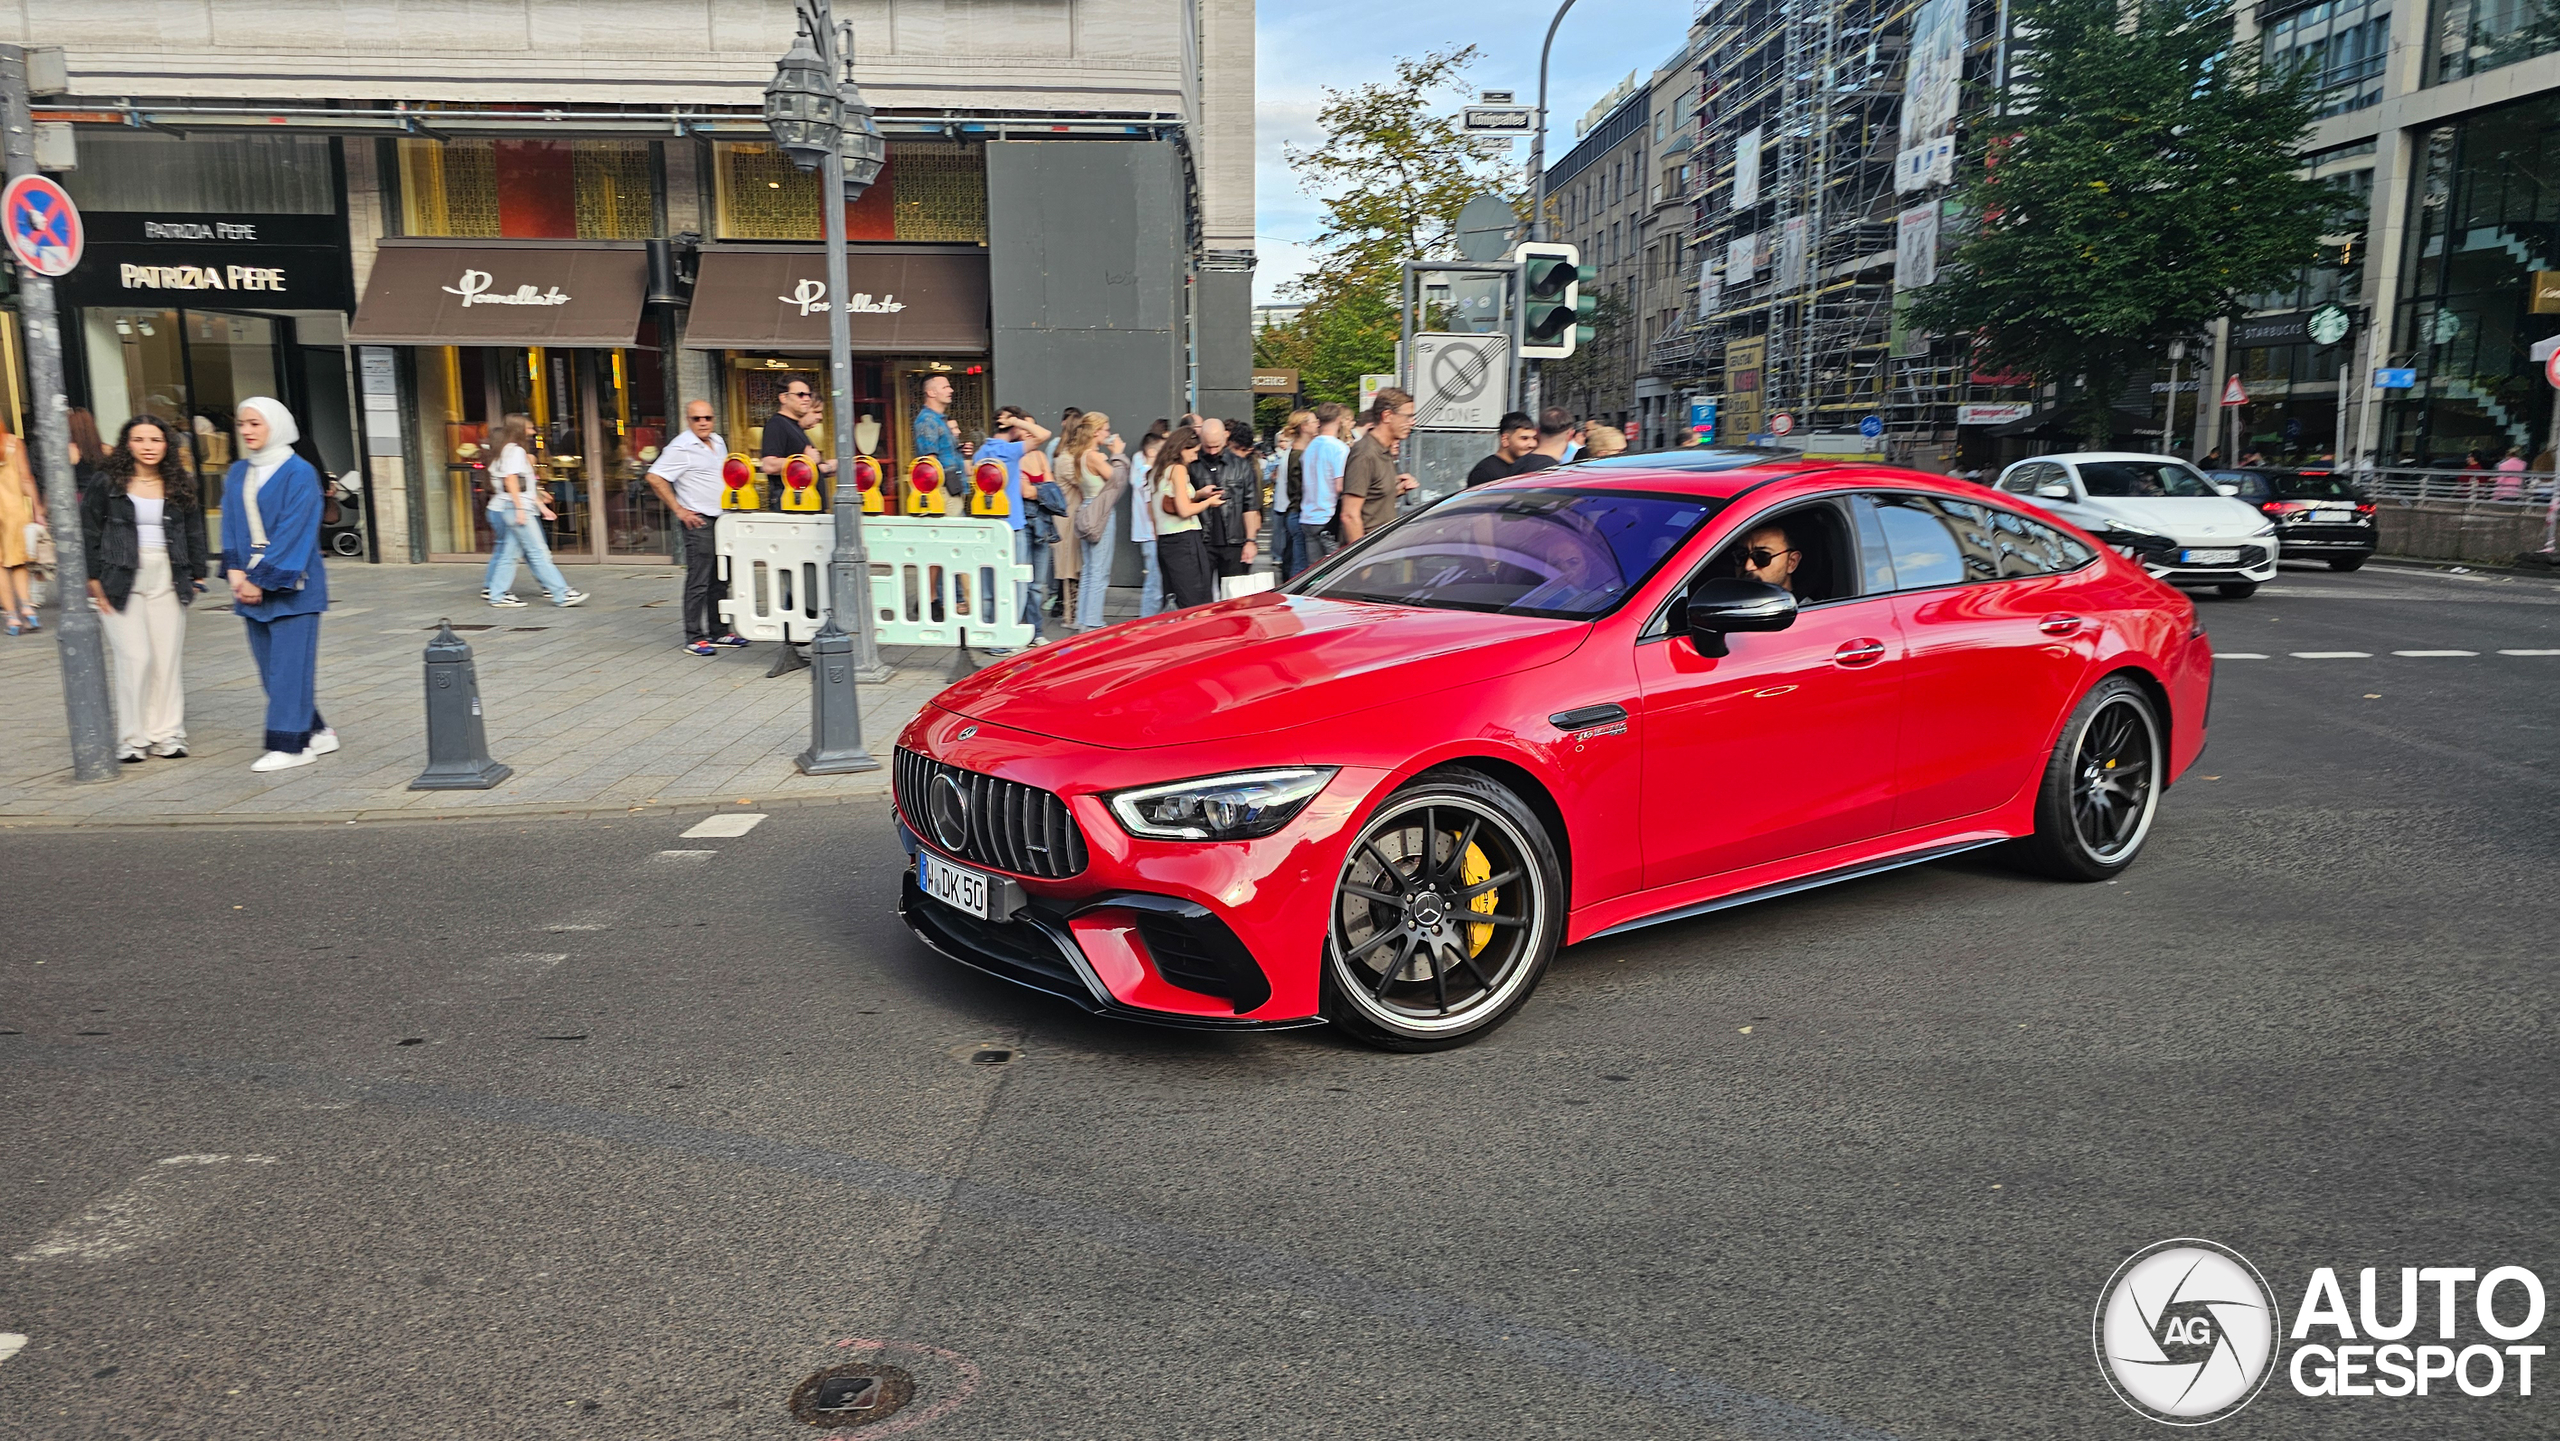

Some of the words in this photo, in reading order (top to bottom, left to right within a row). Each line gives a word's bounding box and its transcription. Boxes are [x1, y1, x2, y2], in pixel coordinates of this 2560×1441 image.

[1468, 112, 1527, 128] Königsallee
[144, 221, 216, 239] PATRIZIA
[216, 222, 258, 240] PEPE
[120, 263, 227, 290] PATRIZIA
[226, 264, 287, 292] PEPE
[2245, 323, 2303, 340] STARBUCKS
[2150, 380, 2201, 394] STARUCKS
[1434, 407, 1481, 423] ZONE
[942, 867, 960, 904] DK
[964, 877, 983, 911] 50
